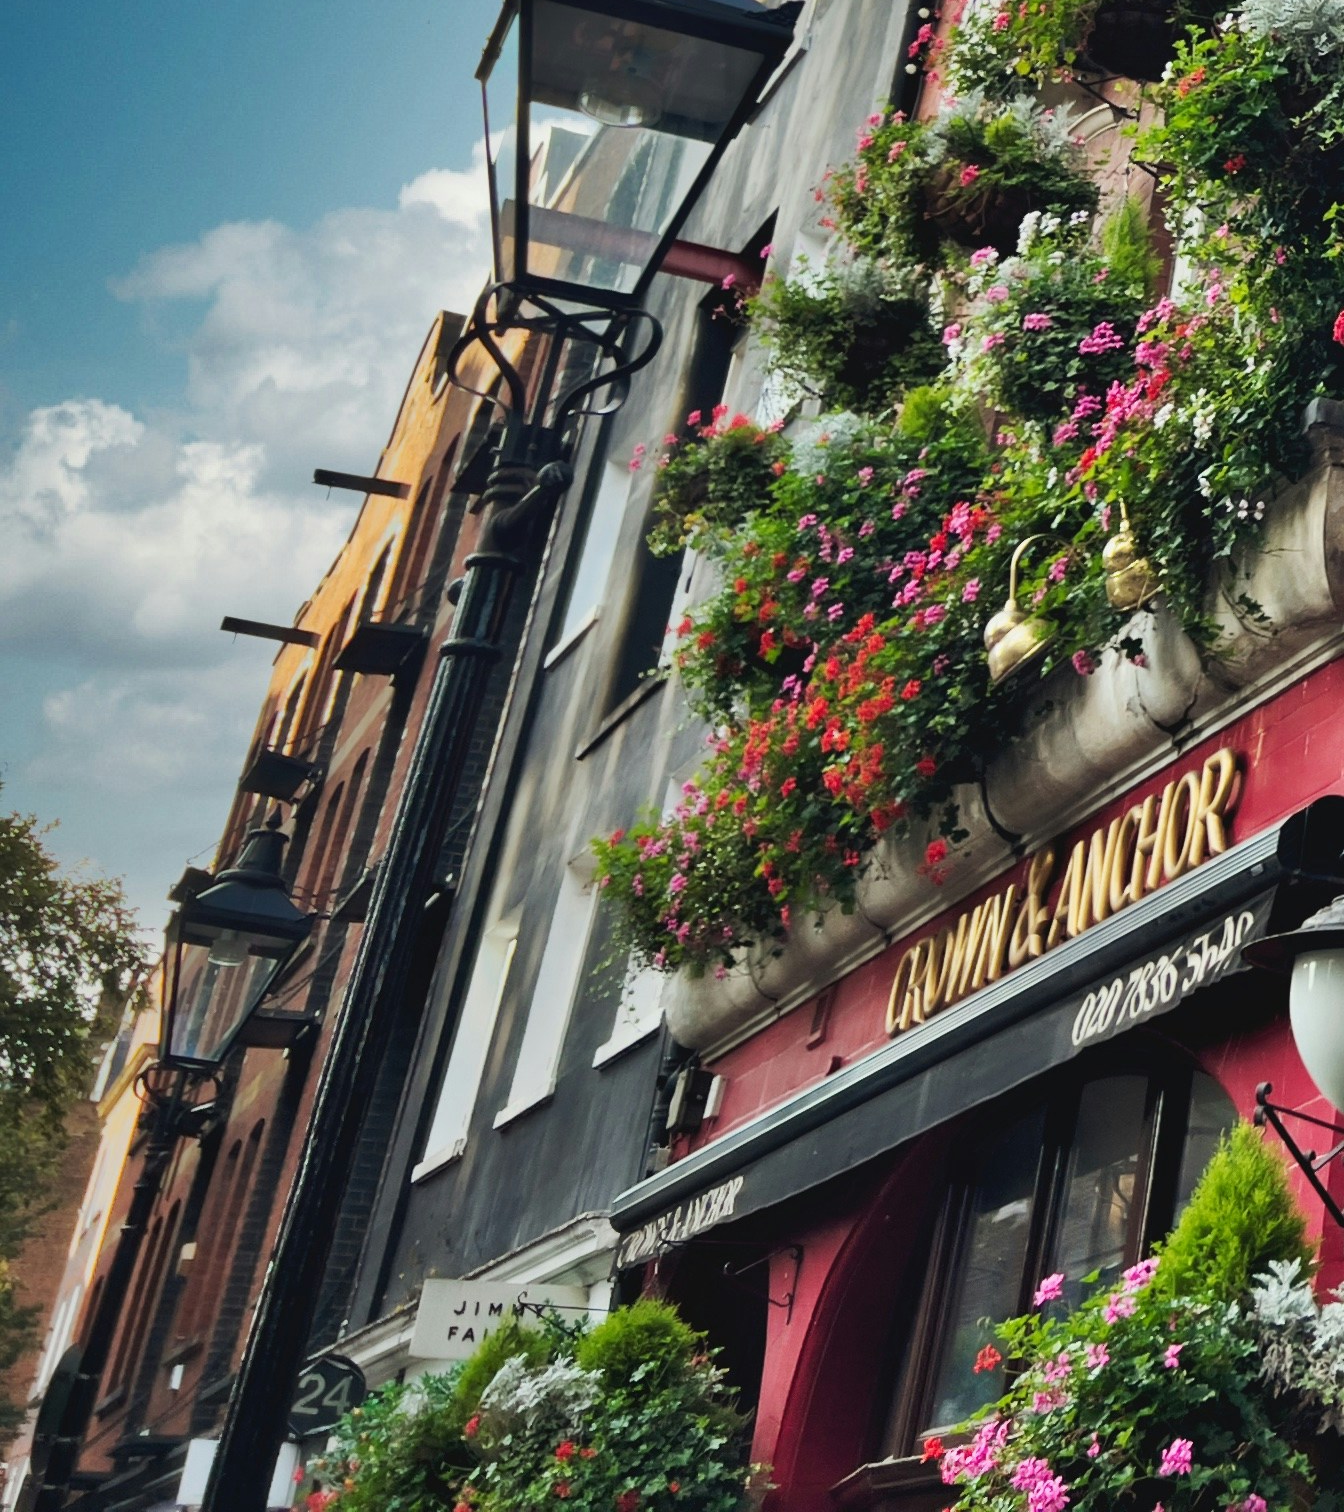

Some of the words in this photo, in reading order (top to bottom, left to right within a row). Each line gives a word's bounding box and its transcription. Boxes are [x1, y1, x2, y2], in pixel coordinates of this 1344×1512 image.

[885, 883, 1016, 1035] CROWN
[1009, 849, 1055, 969] &
[1047, 747, 1237, 948] ANCHOR
[1072, 977, 1123, 1046] 020
[1116, 946, 1184, 1026] 7836
[447, 1325, 489, 1343] FAI
[290, 1373, 354, 1416] 24
